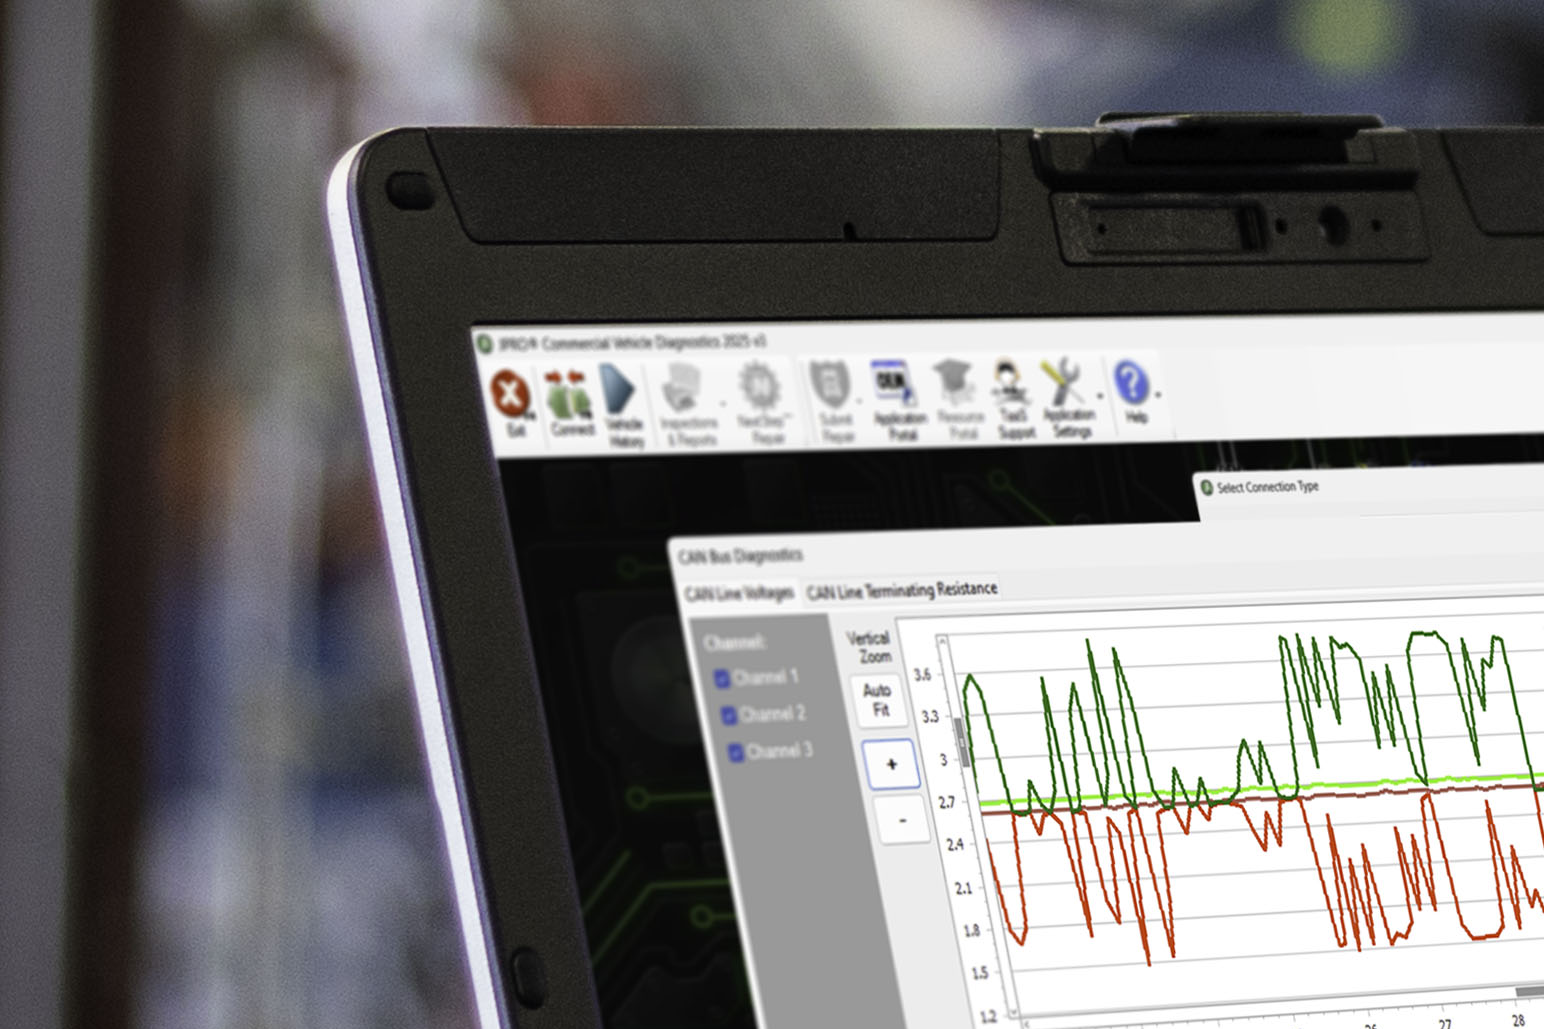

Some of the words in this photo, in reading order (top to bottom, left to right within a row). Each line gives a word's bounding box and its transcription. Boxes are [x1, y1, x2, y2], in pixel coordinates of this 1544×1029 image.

[542, 336, 610, 350] Commercial
[614, 335, 651, 349] Vehicle
[655, 334, 720, 352] Diagnostics
[724, 333, 750, 347] 2025
[605, 417, 643, 432] Vehicle
[874, 411, 928, 427] Application
[1043, 408, 1097, 425] Application
[1126, 411, 1149, 425] Help
[506, 422, 526, 438] Exit
[551, 422, 595, 437] Connect
[998, 423, 1036, 440] Support
[1053, 422, 1092, 440] Settings
[610, 435, 645, 451] History
[1217, 482, 1244, 494] Select
[1246, 480, 1296, 493] Connection
[1298, 479, 1320, 493] Type
[678, 550, 706, 565] CAN
[710, 549, 731, 563] Bus
[733, 548, 804, 566] Diagnostics
[684, 587, 714, 602] CAN
[716, 586, 736, 601] Line
[739, 585, 795, 603] Voltages
[806, 585, 835, 600] CAN
[839, 584, 862, 600] Line
[864, 581, 936, 601] Terminating
[937, 580, 998, 596] Resistance
[703, 633, 766, 651] Channel:
[847, 630, 890, 646] Vertical
[859, 649, 892, 665] Zoom
[733, 669, 788, 686] Channel
[791, 668, 799, 684] 1
[914, 667, 932, 682] 3.6
[863, 682, 892, 698] Auto
[741, 706, 794, 724] Channel
[797, 704, 807, 721] 2
[873, 702, 890, 718] Fit
[922, 709, 940, 724] 3.3
[747, 743, 801, 760] Channel
[804, 741, 814, 758] 3
[940, 752, 948, 767] 3
[938, 794, 955, 810] 2.7
[946, 837, 964, 852] 2.4
[955, 881, 972, 897] 2.1
[963, 923, 981, 938] 1.8
[972, 965, 989, 981] 1.5
[980, 1009, 998, 1025] 1.2
[1512, 1013, 1527, 1028] 28
